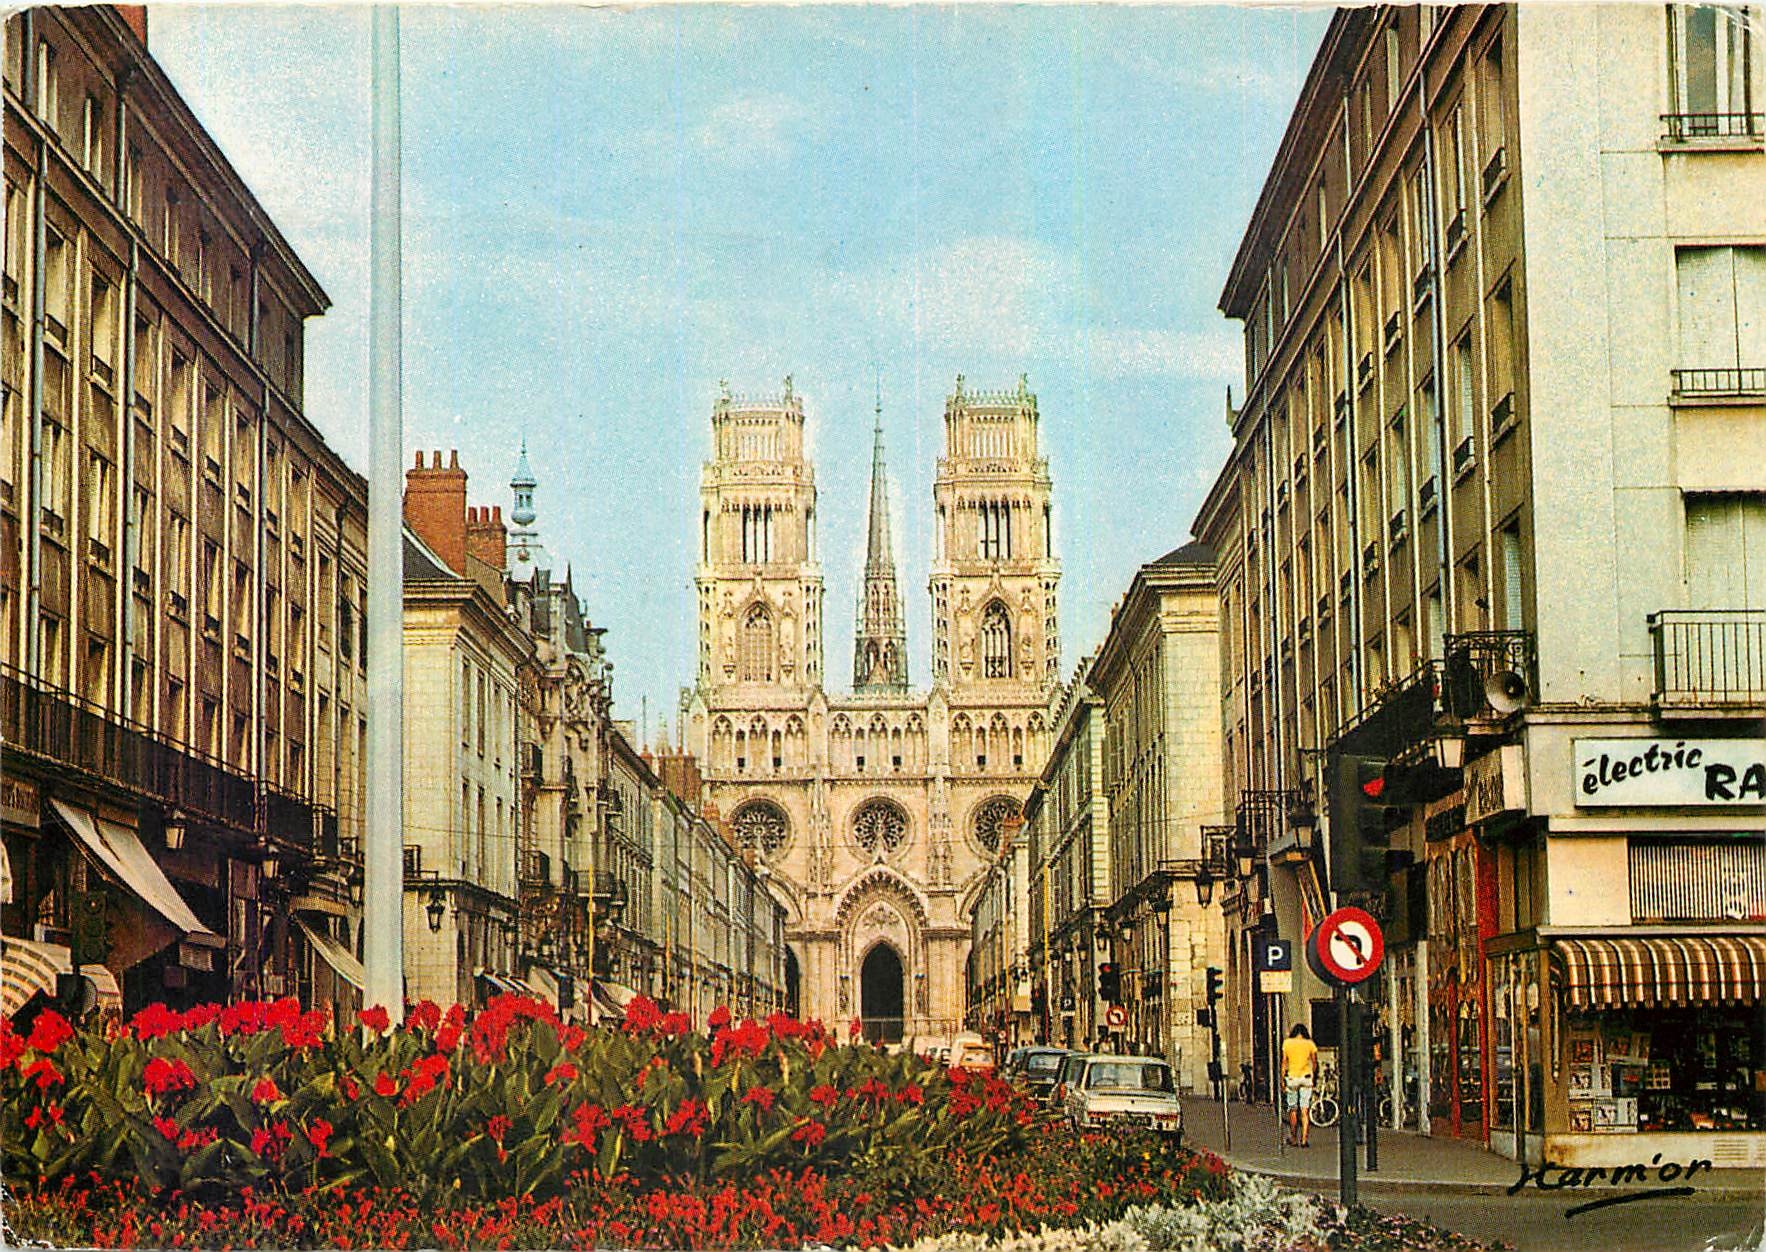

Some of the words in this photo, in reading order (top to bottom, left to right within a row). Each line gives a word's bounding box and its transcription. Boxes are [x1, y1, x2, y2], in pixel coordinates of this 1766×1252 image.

[1583, 742, 1703, 795] électric
[1705, 763, 1766, 801] RA
[1268, 945, 1283, 967] P
